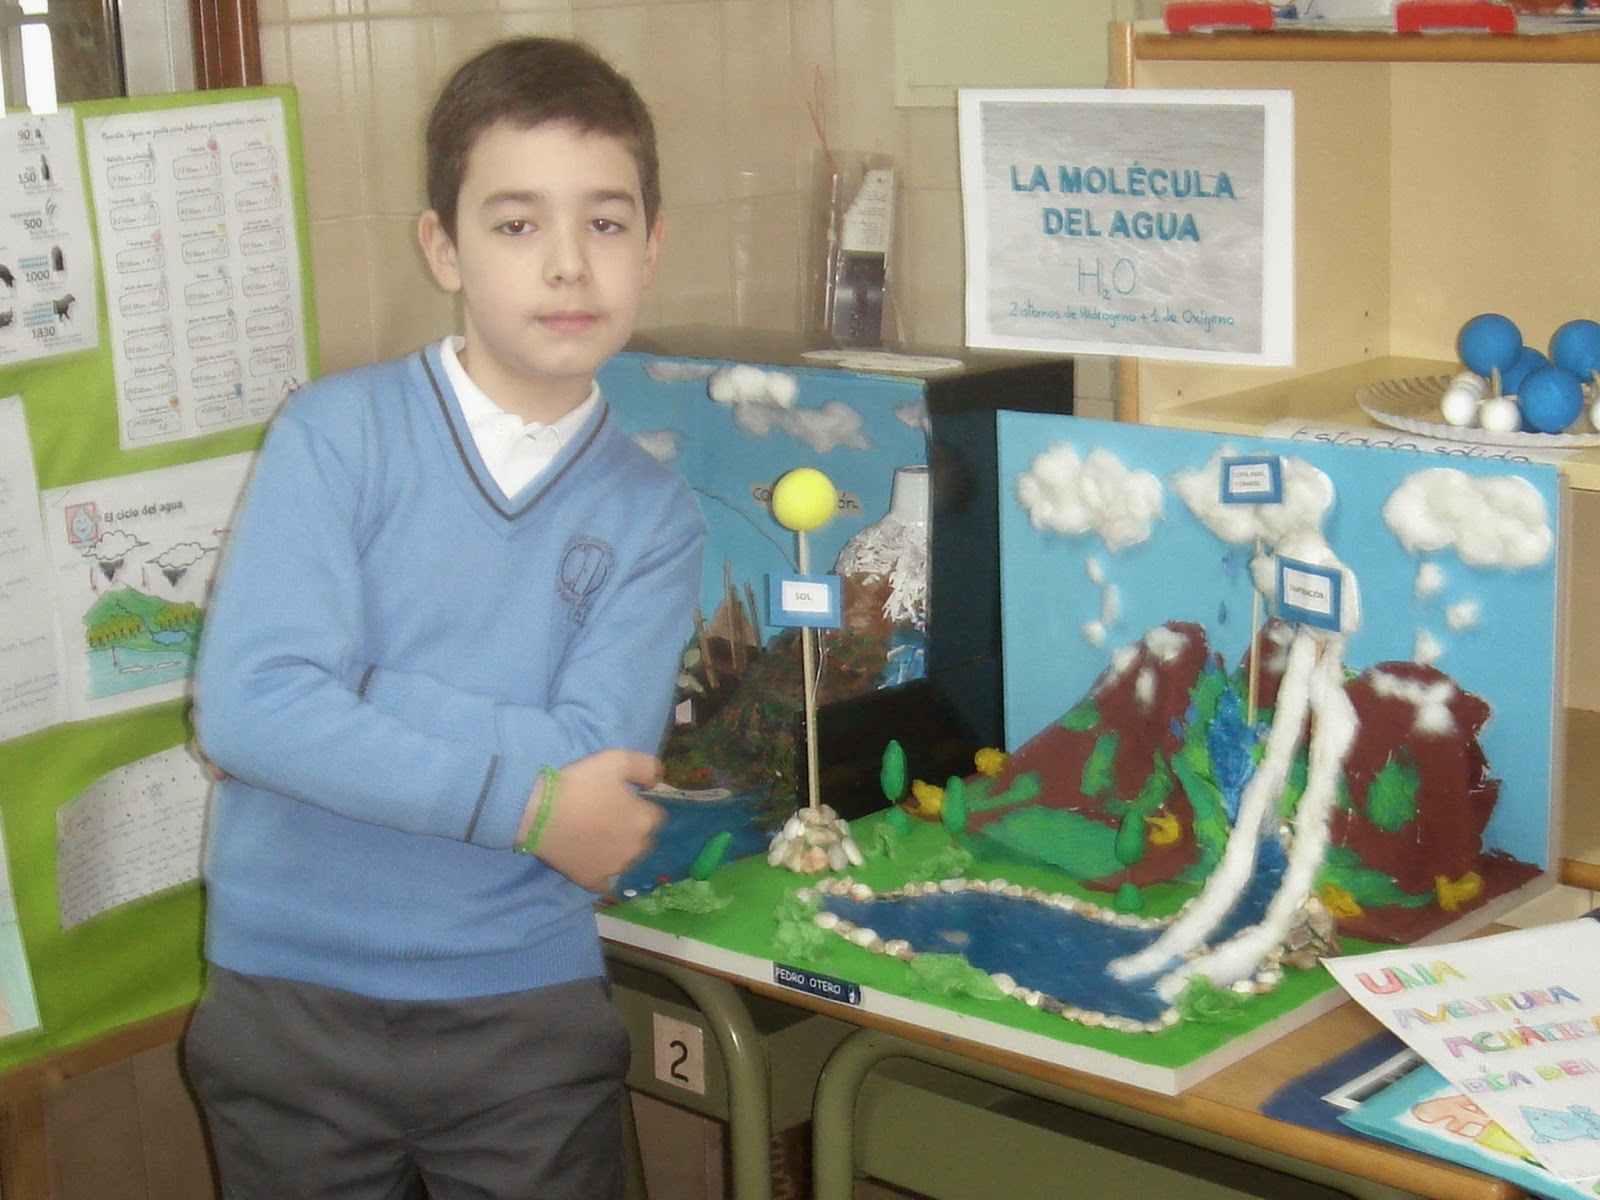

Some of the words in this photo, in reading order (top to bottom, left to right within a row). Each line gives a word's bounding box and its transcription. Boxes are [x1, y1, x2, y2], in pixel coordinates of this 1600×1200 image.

[18, 129, 30, 140] 90
[18, 172, 36, 184] 150
[1010, 164, 1051, 192] LA
[1058, 160, 1237, 199] MOLÉCULA
[24, 218, 42, 230] 500
[1042, 207, 1101, 238] DEL
[1108, 209, 1200, 242] AGUA
[26, 269, 50, 282] 1000
[1009, 301, 1018, 317] 2
[1064, 305, 1077, 320] de
[104, 512, 113, 522] El
[116, 508, 139, 520] ciclo
[141, 502, 157, 515] del
[159, 501, 183, 513] agua
[795, 592, 814, 601] SOL
[775, 966, 805, 985] PEDRO
[809, 979, 841, 995] OTERO
[1355, 960, 1465, 995] UNA
[669, 1040, 689, 1082] 2
